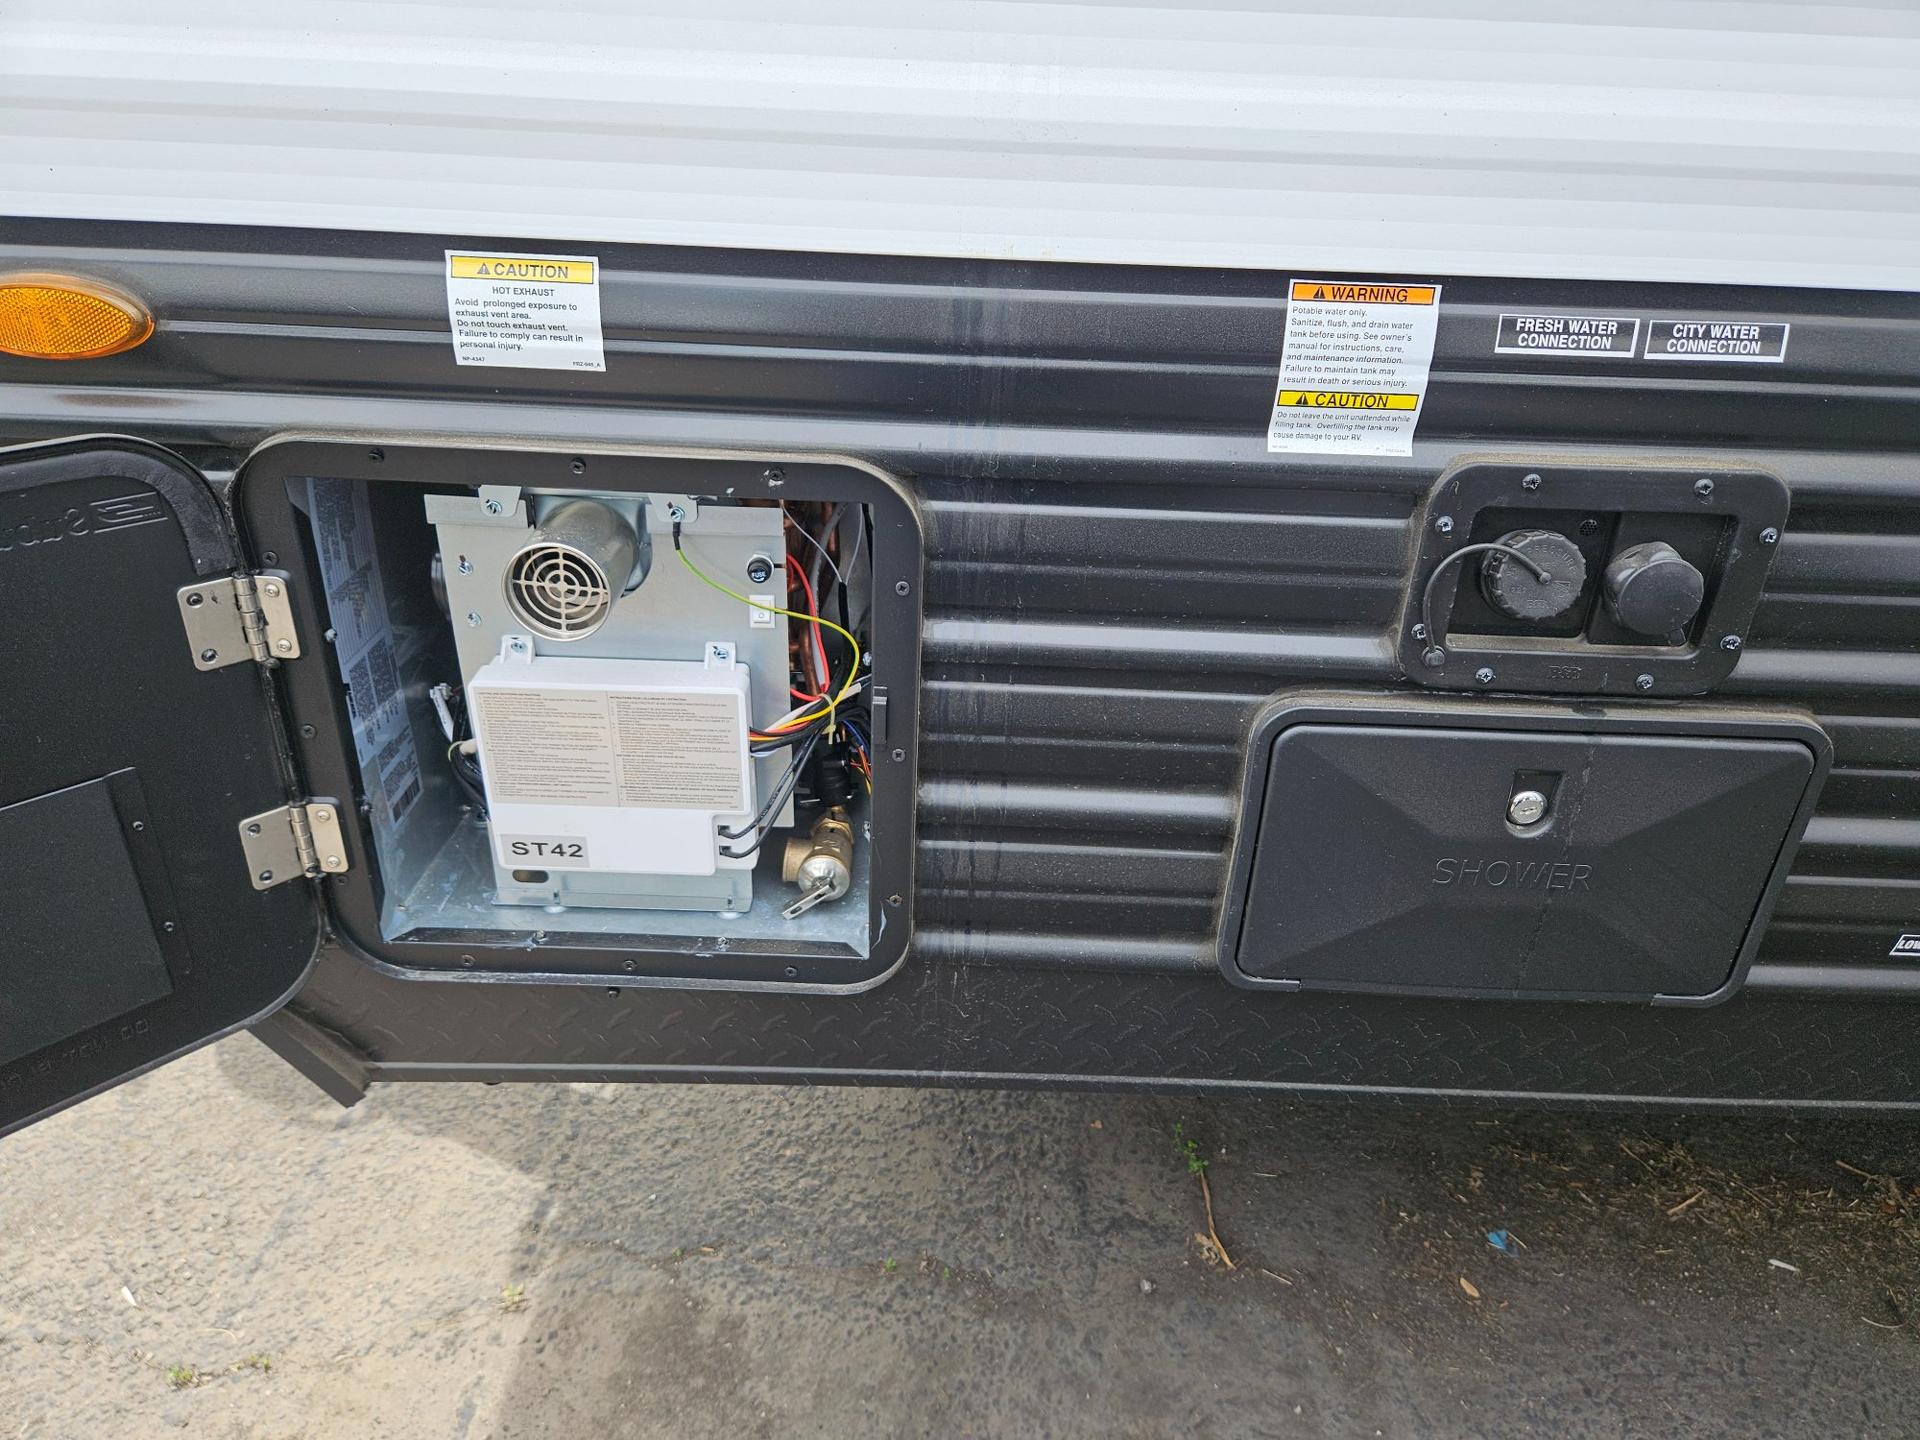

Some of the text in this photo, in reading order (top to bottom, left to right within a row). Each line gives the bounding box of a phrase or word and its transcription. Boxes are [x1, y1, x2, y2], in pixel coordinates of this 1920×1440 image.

[494, 263, 568, 278] CAUTION
[514, 288, 554, 296] EXHAUST
[1332, 287, 1408, 302] WARNING
[483, 300, 525, 309] prolonged
[529, 302, 566, 310] exposure
[1349, 309, 1367, 317] only.
[1292, 319, 1324, 327] Sanitize,
[1516, 319, 1617, 334] FRESH WATER
[500, 332, 530, 341] comply
[1337, 333, 1361, 341] using.
[1673, 324, 1760, 339] CITY WATER
[498, 342, 523, 351] injury.
[1518, 334, 1612, 349] CONNECTION
[1667, 339, 1760, 354] CONNECTION
[1333, 344, 1382, 352] instructions,
[1315, 394, 1388, 407] CAUTION
[1296, 432, 1322, 441] damage
[512, 842, 584, 858] ST42
[1432, 858, 1593, 890] SHOWER
